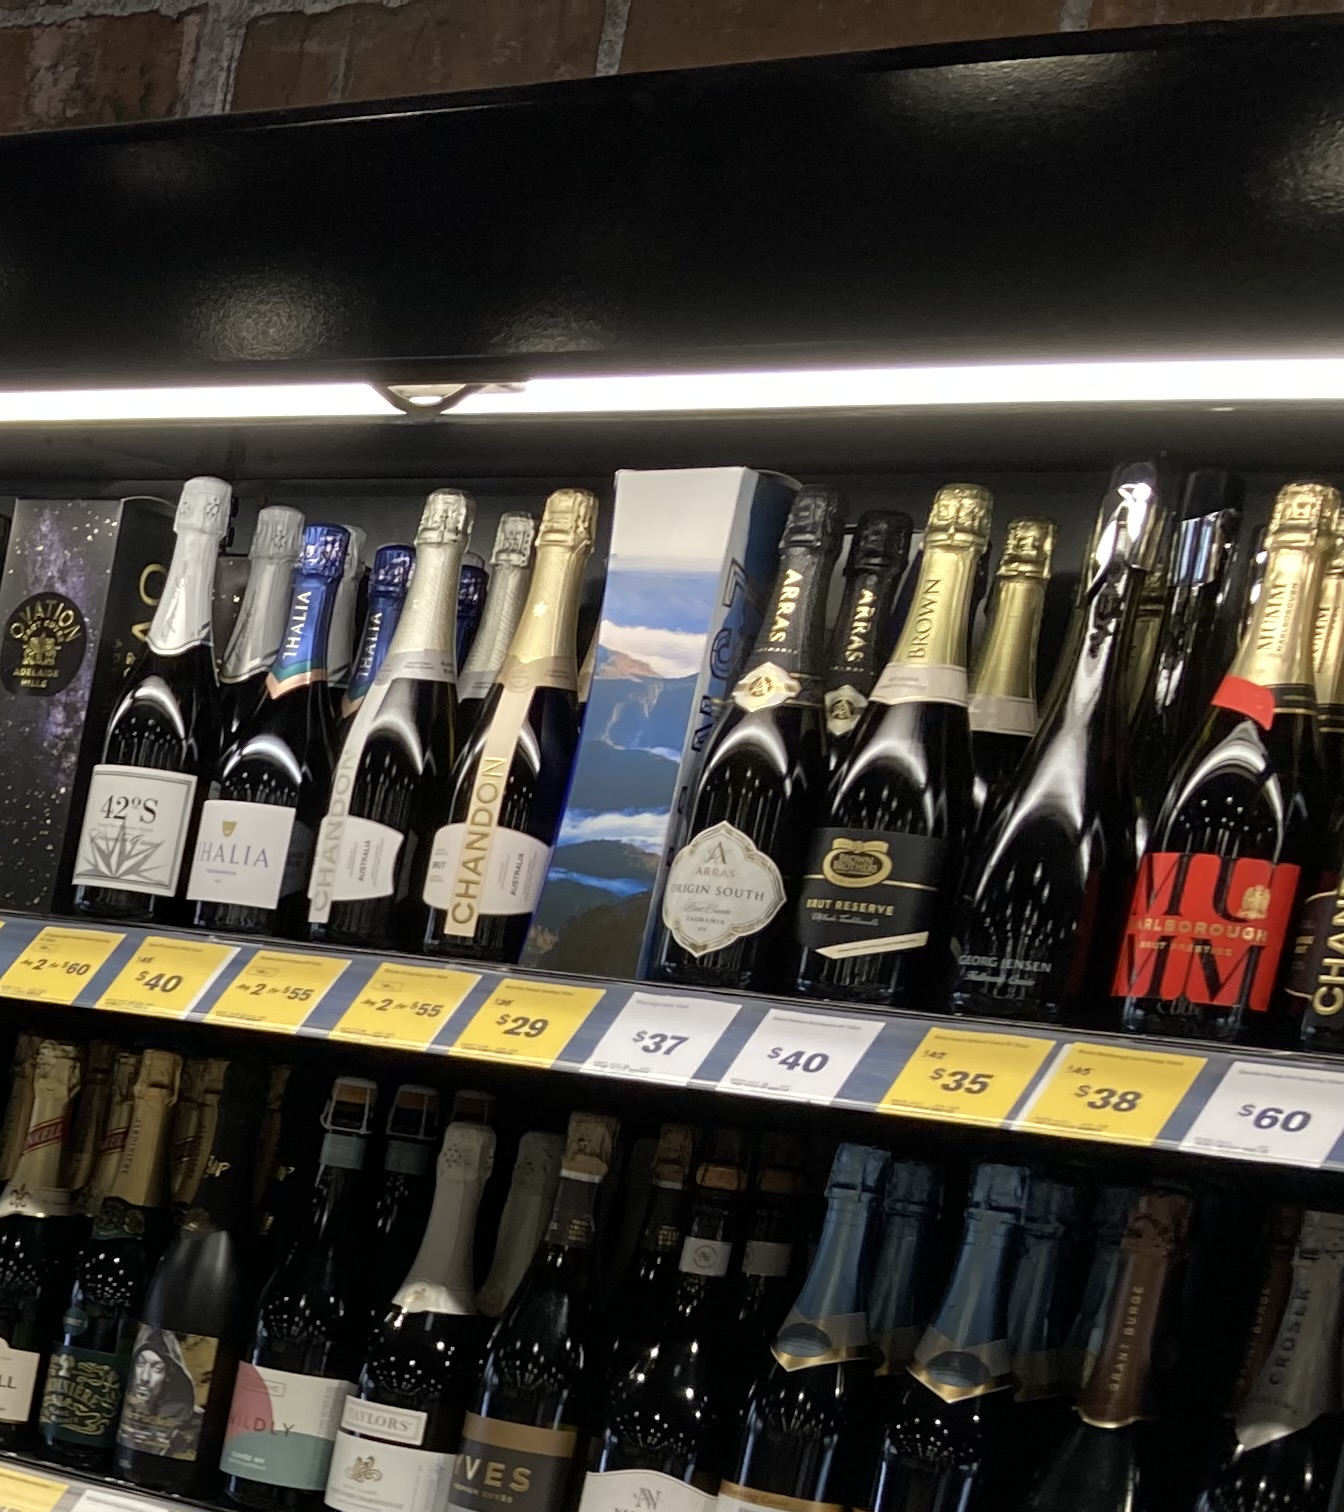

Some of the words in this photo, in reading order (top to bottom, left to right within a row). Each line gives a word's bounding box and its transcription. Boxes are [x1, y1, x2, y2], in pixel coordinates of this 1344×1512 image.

[768, 567, 802, 645] ARRAS
[908, 577, 942, 659] BROWN
[10, 600, 82, 642] OVATION
[846, 588, 877, 667] ARRAS
[313, 748, 357, 913] CHANDON
[451, 755, 505, 925] CHANDON
[715, 886, 765, 901] SOUTH
[835, 900, 894, 916] RESERVE
[135, 971, 183, 994] $40
[497, 1013, 549, 1038] $29
[632, 1030, 689, 1055] $37
[767, 1046, 829, 1074] $40
[929, 1067, 993, 1095] $35
[1074, 1084, 1142, 1113] $38
[1238, 1104, 1311, 1132] $60
